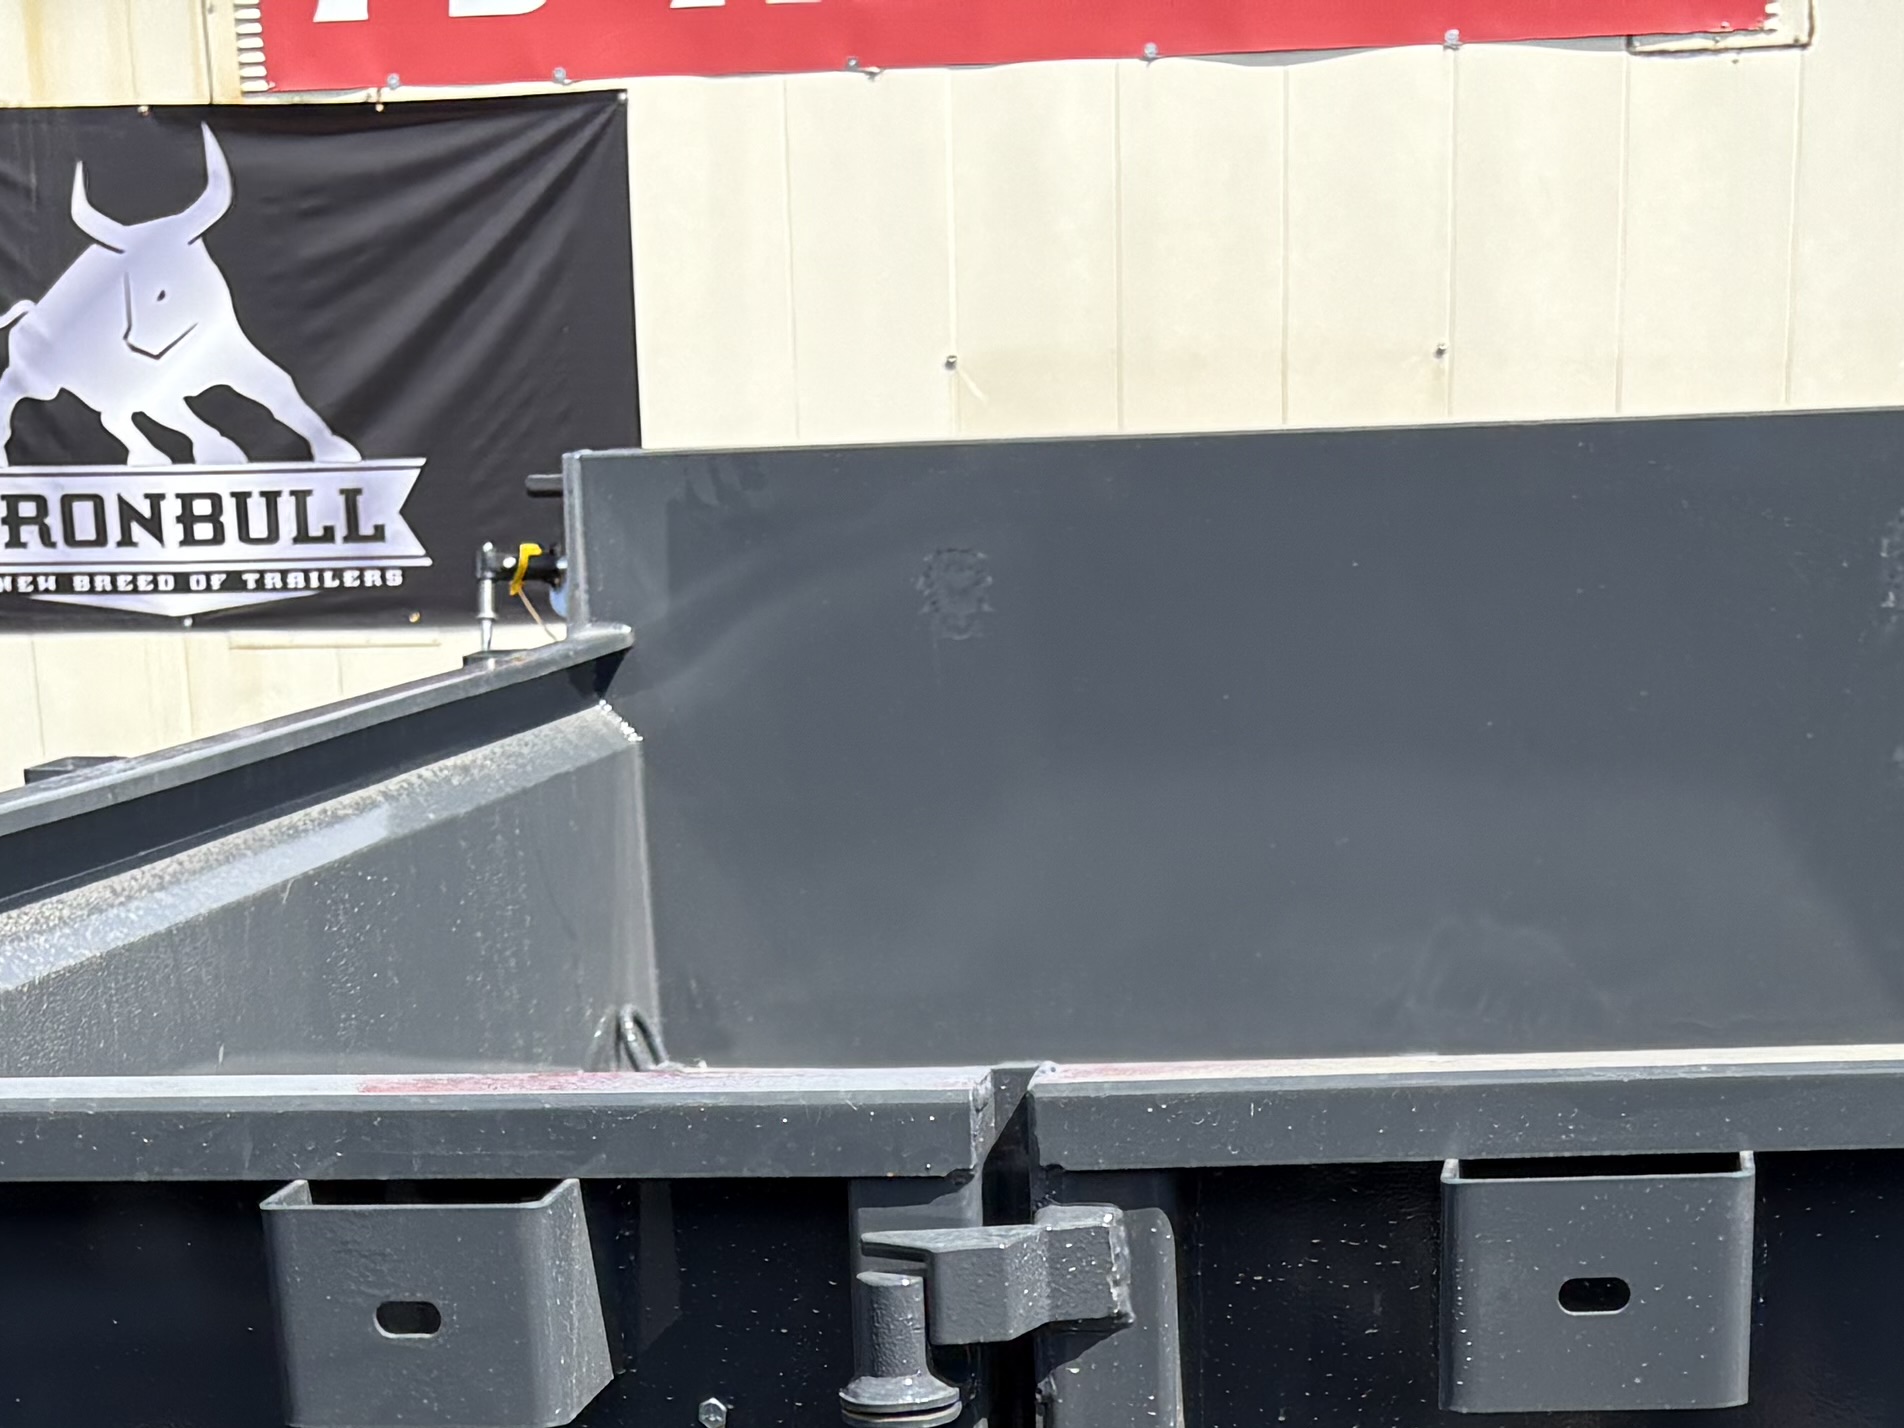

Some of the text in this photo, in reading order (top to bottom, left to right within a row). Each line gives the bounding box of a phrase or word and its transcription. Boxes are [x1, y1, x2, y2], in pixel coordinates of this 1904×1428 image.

[73, 572, 175, 592] BREED
[190, 572, 228, 591] OF
[243, 569, 404, 591] TRAILERS
